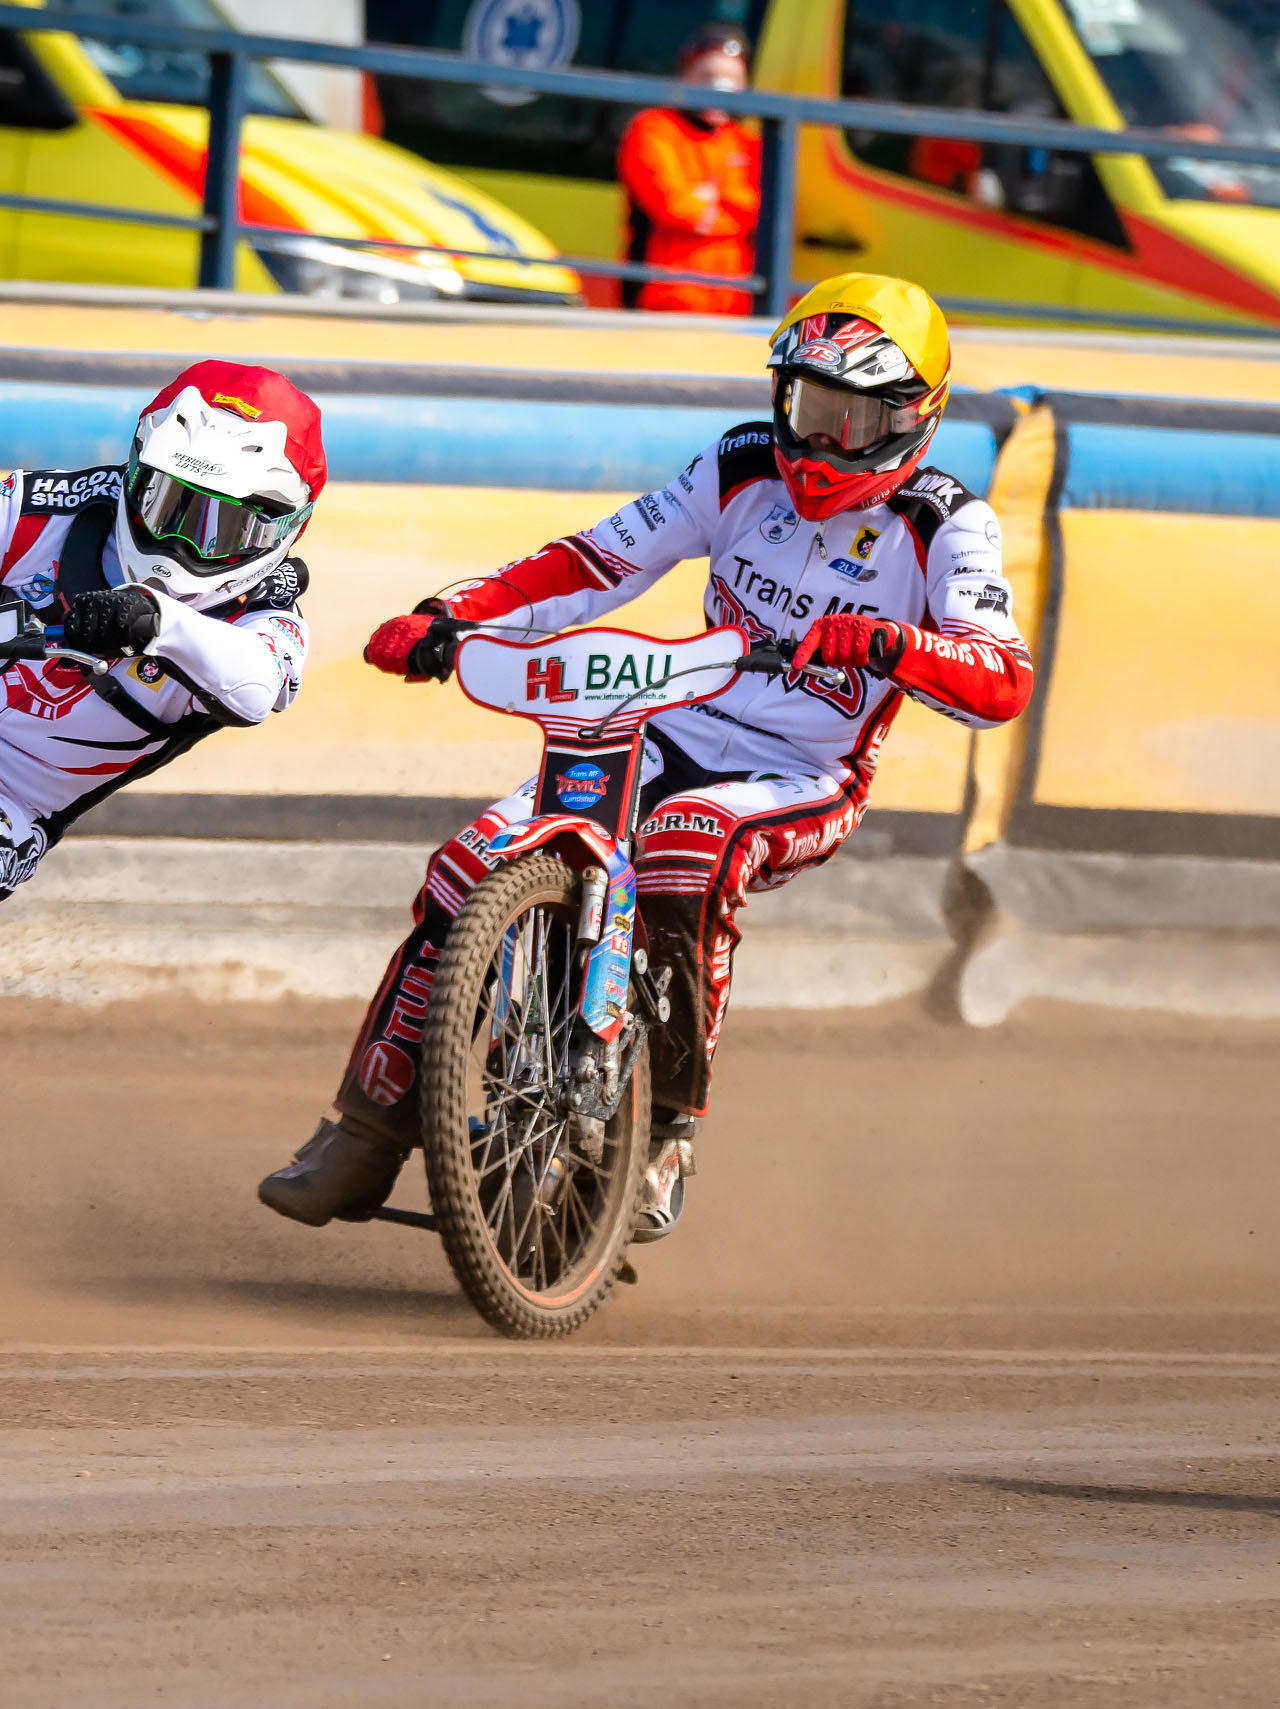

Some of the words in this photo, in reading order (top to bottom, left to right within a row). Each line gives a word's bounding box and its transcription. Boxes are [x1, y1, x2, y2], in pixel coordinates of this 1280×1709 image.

[720, 430, 770, 456] Trans
[171, 453, 217, 472] MERIDIAN
[176, 461, 202, 474] LIFTS
[32, 471, 123, 494] HAGON
[31, 484, 121, 508] SHOCKS
[610, 513, 636, 549] OLAR
[734, 556, 814, 620] Trans
[585, 654, 672, 690] BAU
[555, 773, 611, 796] DEVILS
[642, 814, 725, 837] B.R.M.
